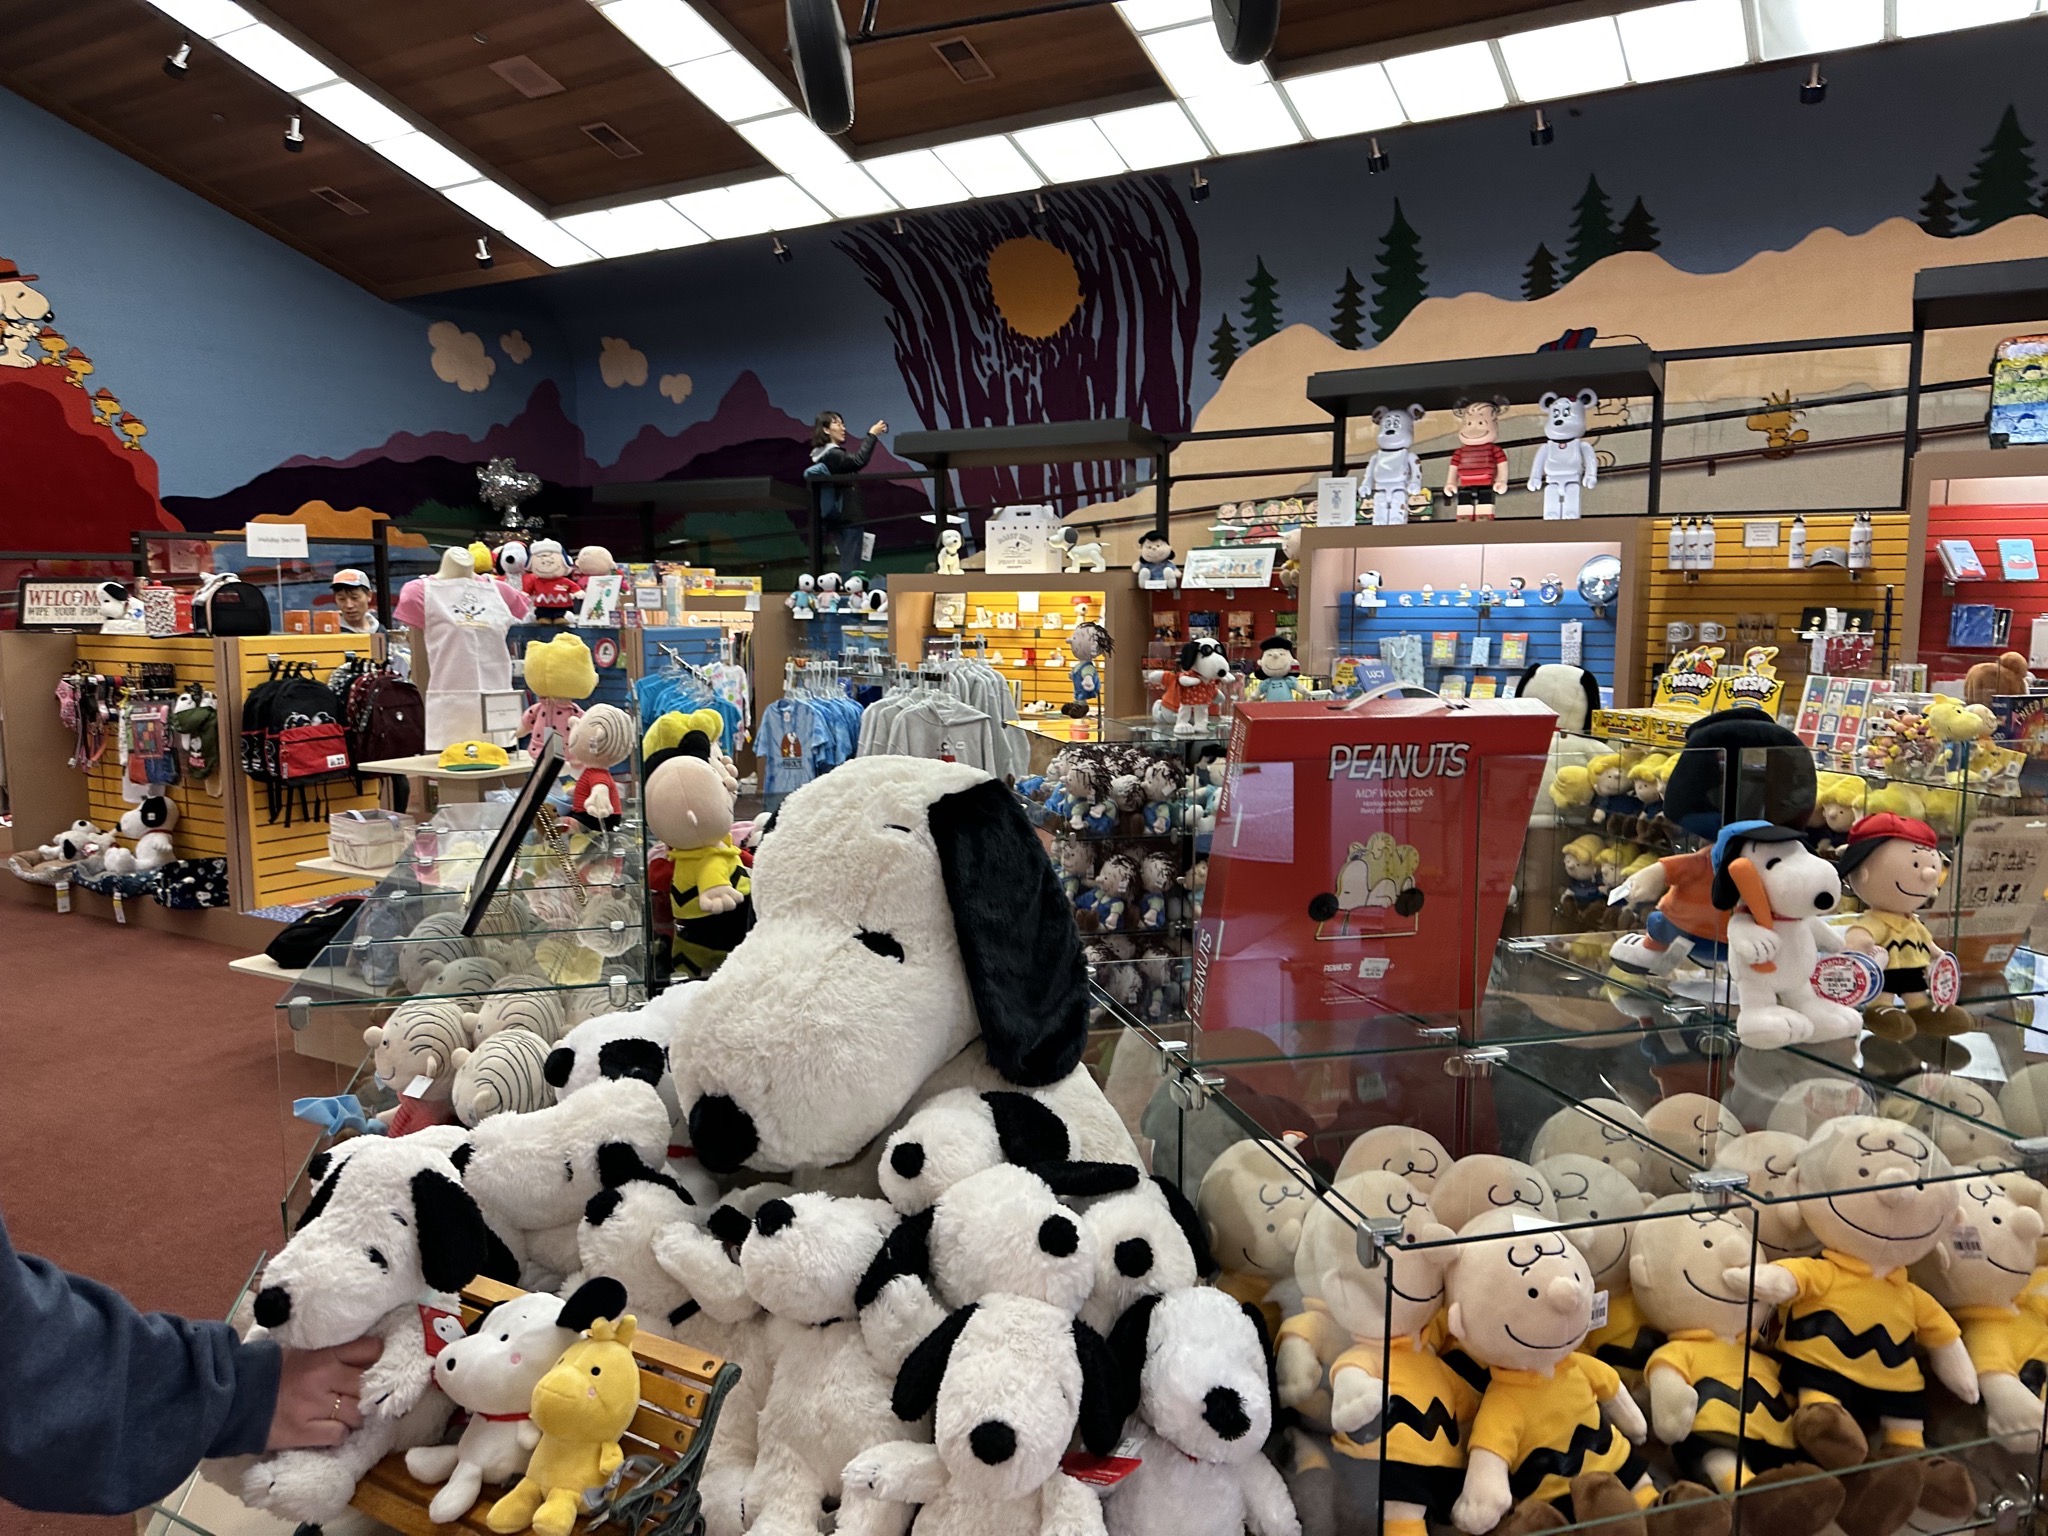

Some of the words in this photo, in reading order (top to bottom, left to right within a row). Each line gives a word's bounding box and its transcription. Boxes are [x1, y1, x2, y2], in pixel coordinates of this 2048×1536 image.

[28, 608, 50, 617] WIPE
[54, 608, 76, 617] YOUR
[1327, 742, 1471, 780] PEANUTS
[1355, 788, 1377, 798] MDF
[1380, 788, 1407, 797] Wood
[1409, 787, 1434, 797] Clock
[1192, 928, 1212, 1017] PEANUTS
